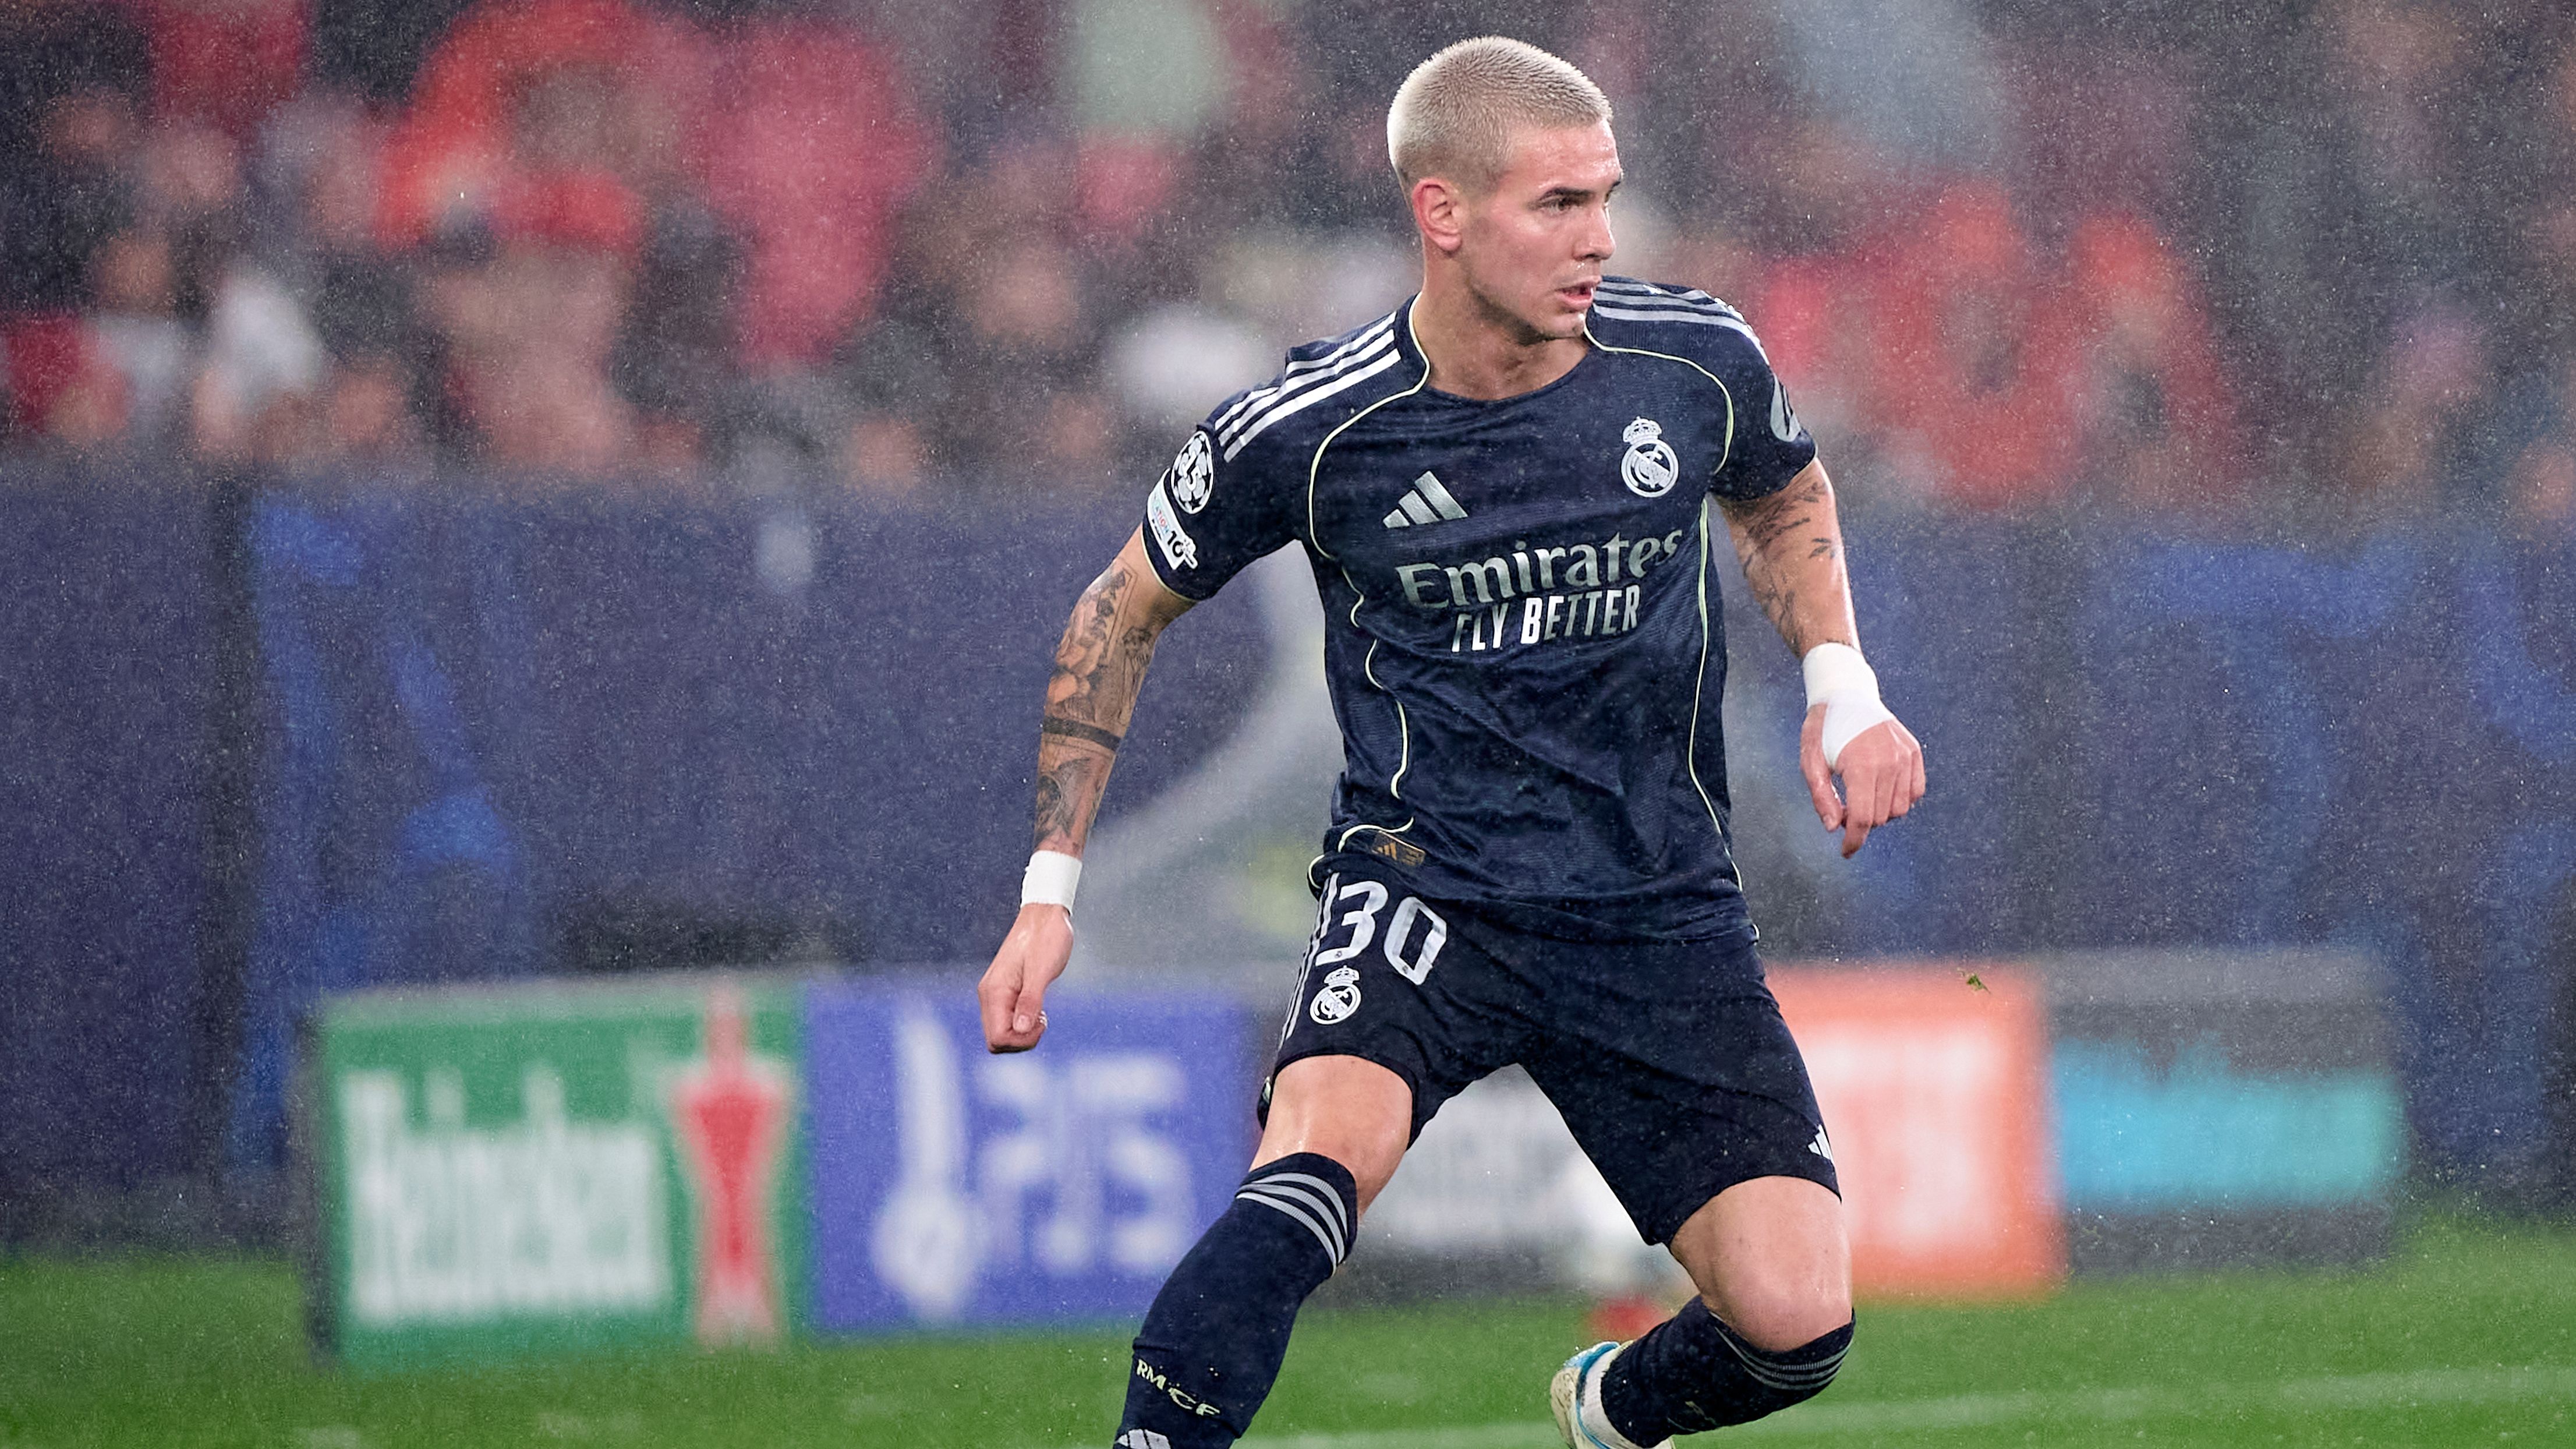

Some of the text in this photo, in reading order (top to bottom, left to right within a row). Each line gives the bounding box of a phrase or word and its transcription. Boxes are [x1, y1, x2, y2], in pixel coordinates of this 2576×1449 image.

[1395, 529, 1683, 611] Emirates
[1451, 584, 1641, 653] FLY BETTER
[1315, 881, 1448, 985] 30
